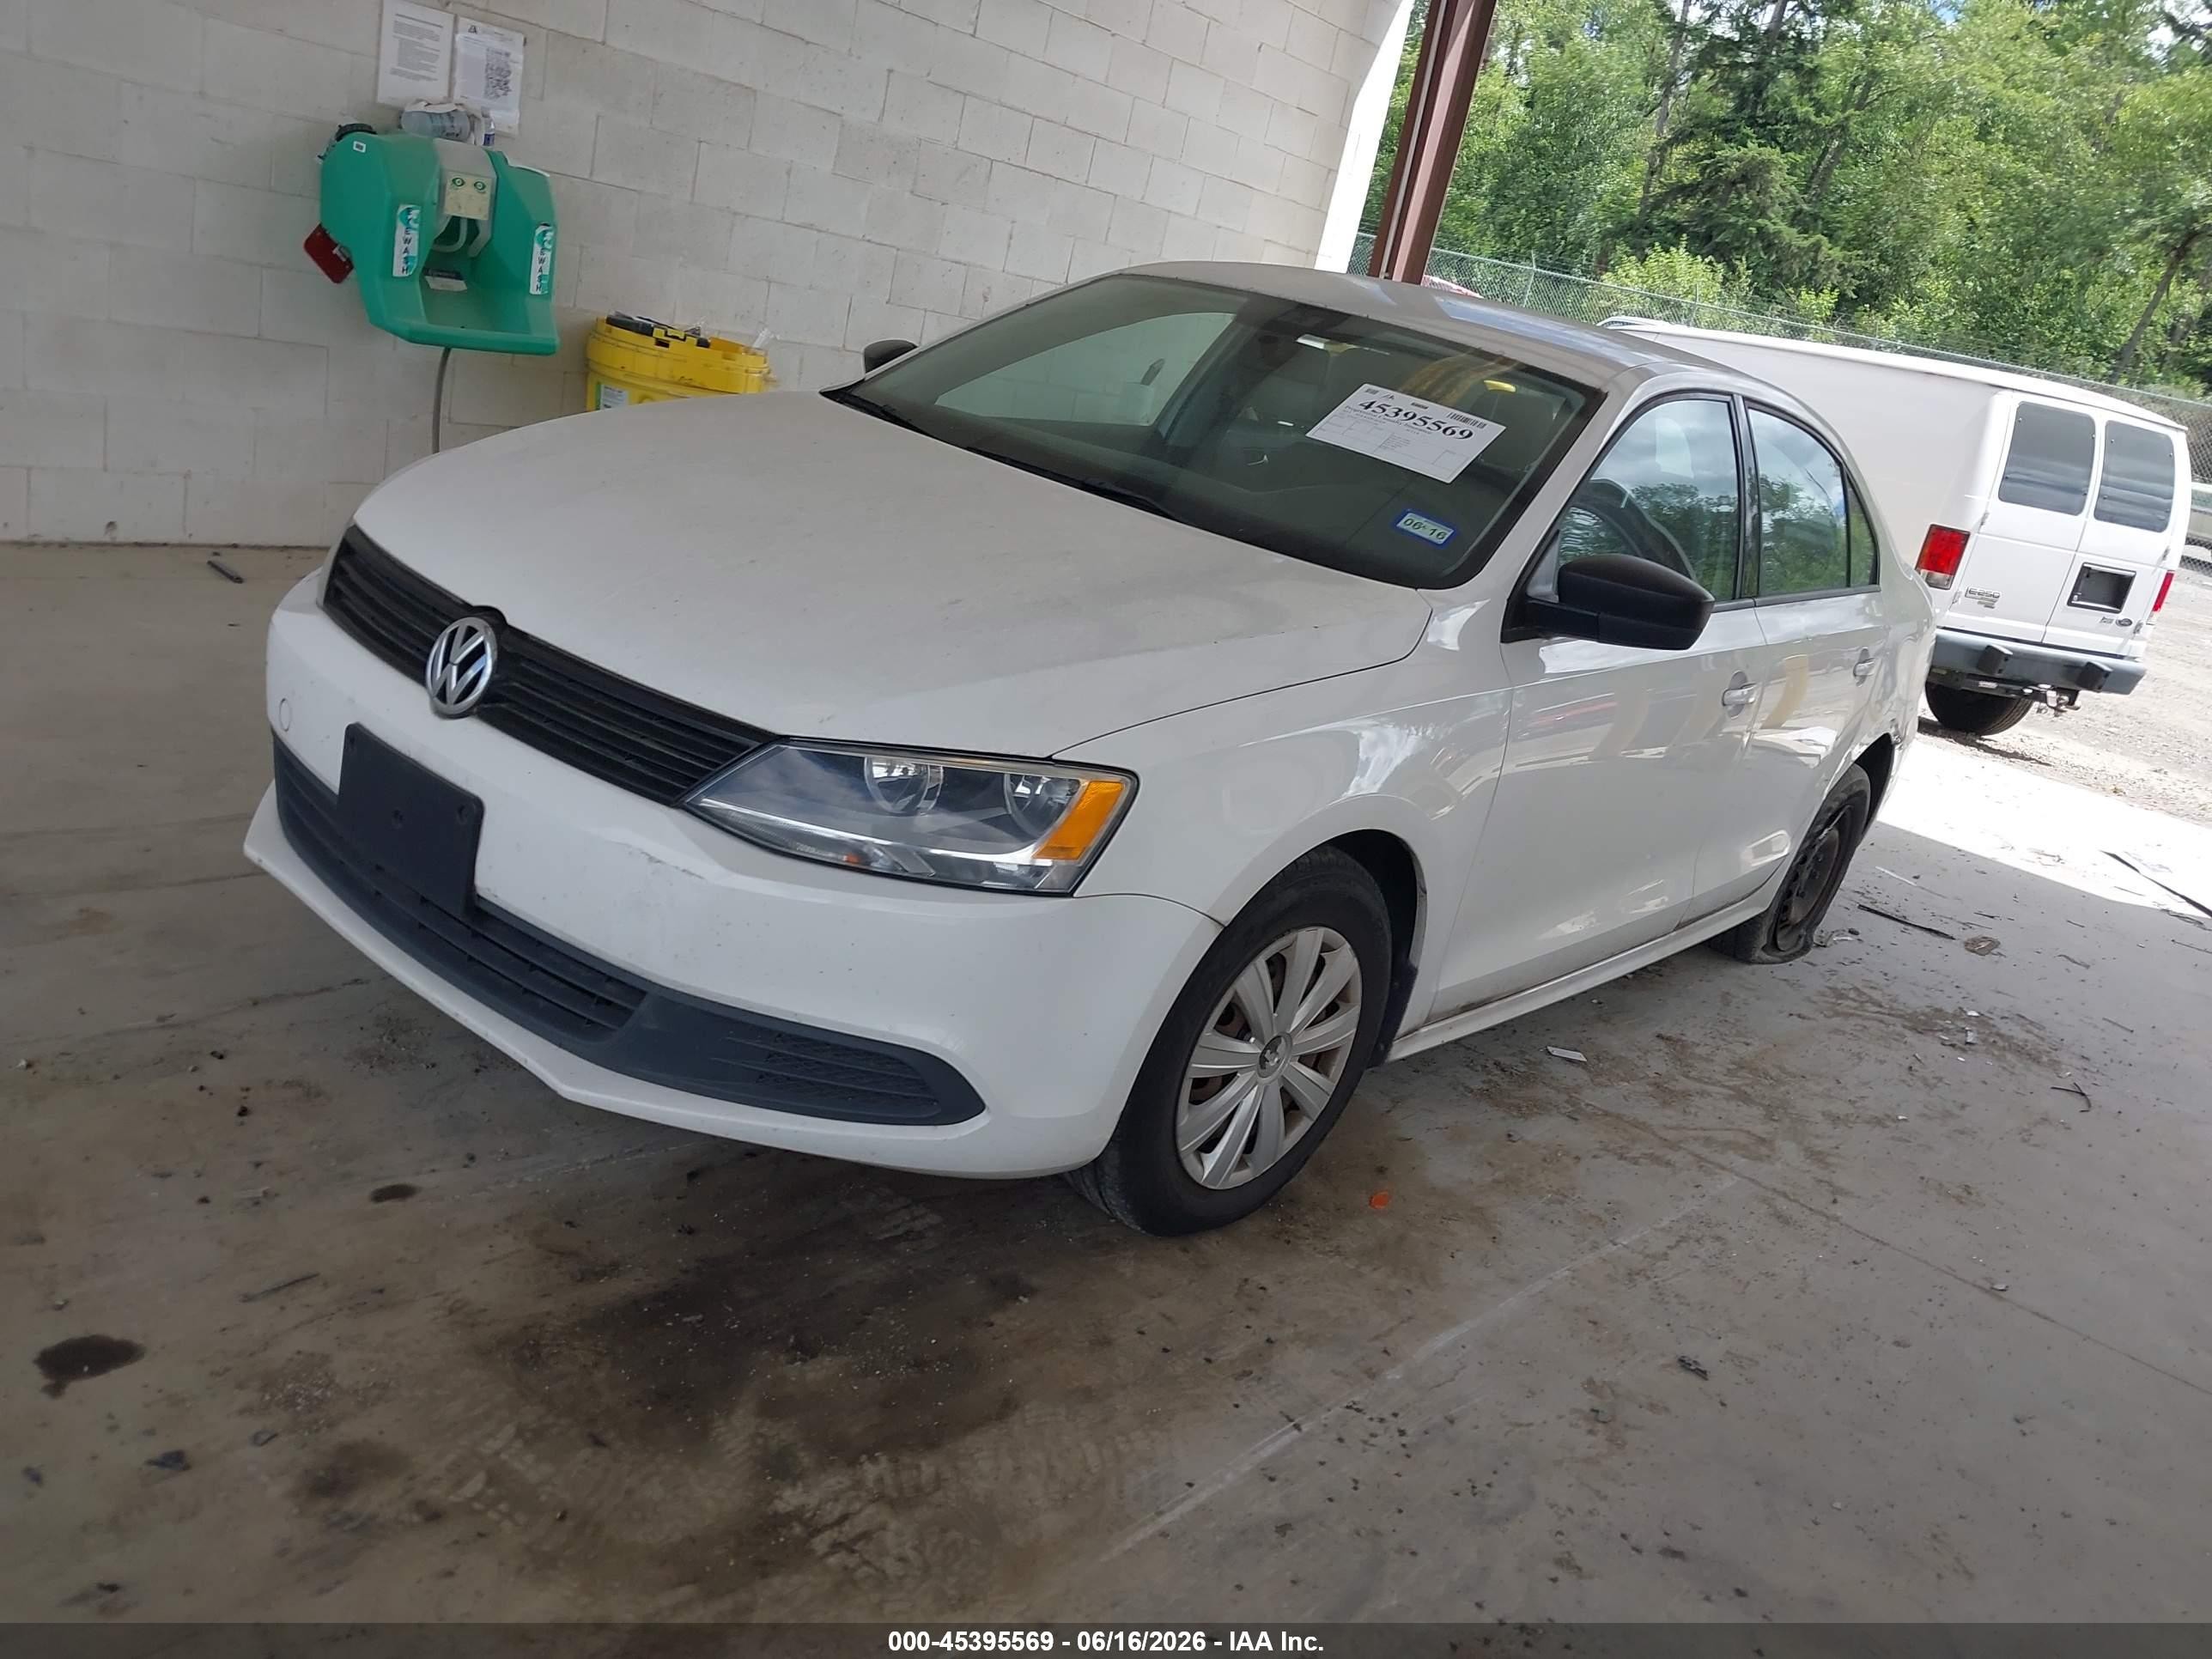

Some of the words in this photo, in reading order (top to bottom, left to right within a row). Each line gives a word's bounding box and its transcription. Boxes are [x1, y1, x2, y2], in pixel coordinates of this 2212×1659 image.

[1358, 398, 1474, 441] 45395569
[1403, 518, 1422, 530] 06
[1429, 528, 1448, 540] 16
[428, 618, 491, 713] VW
